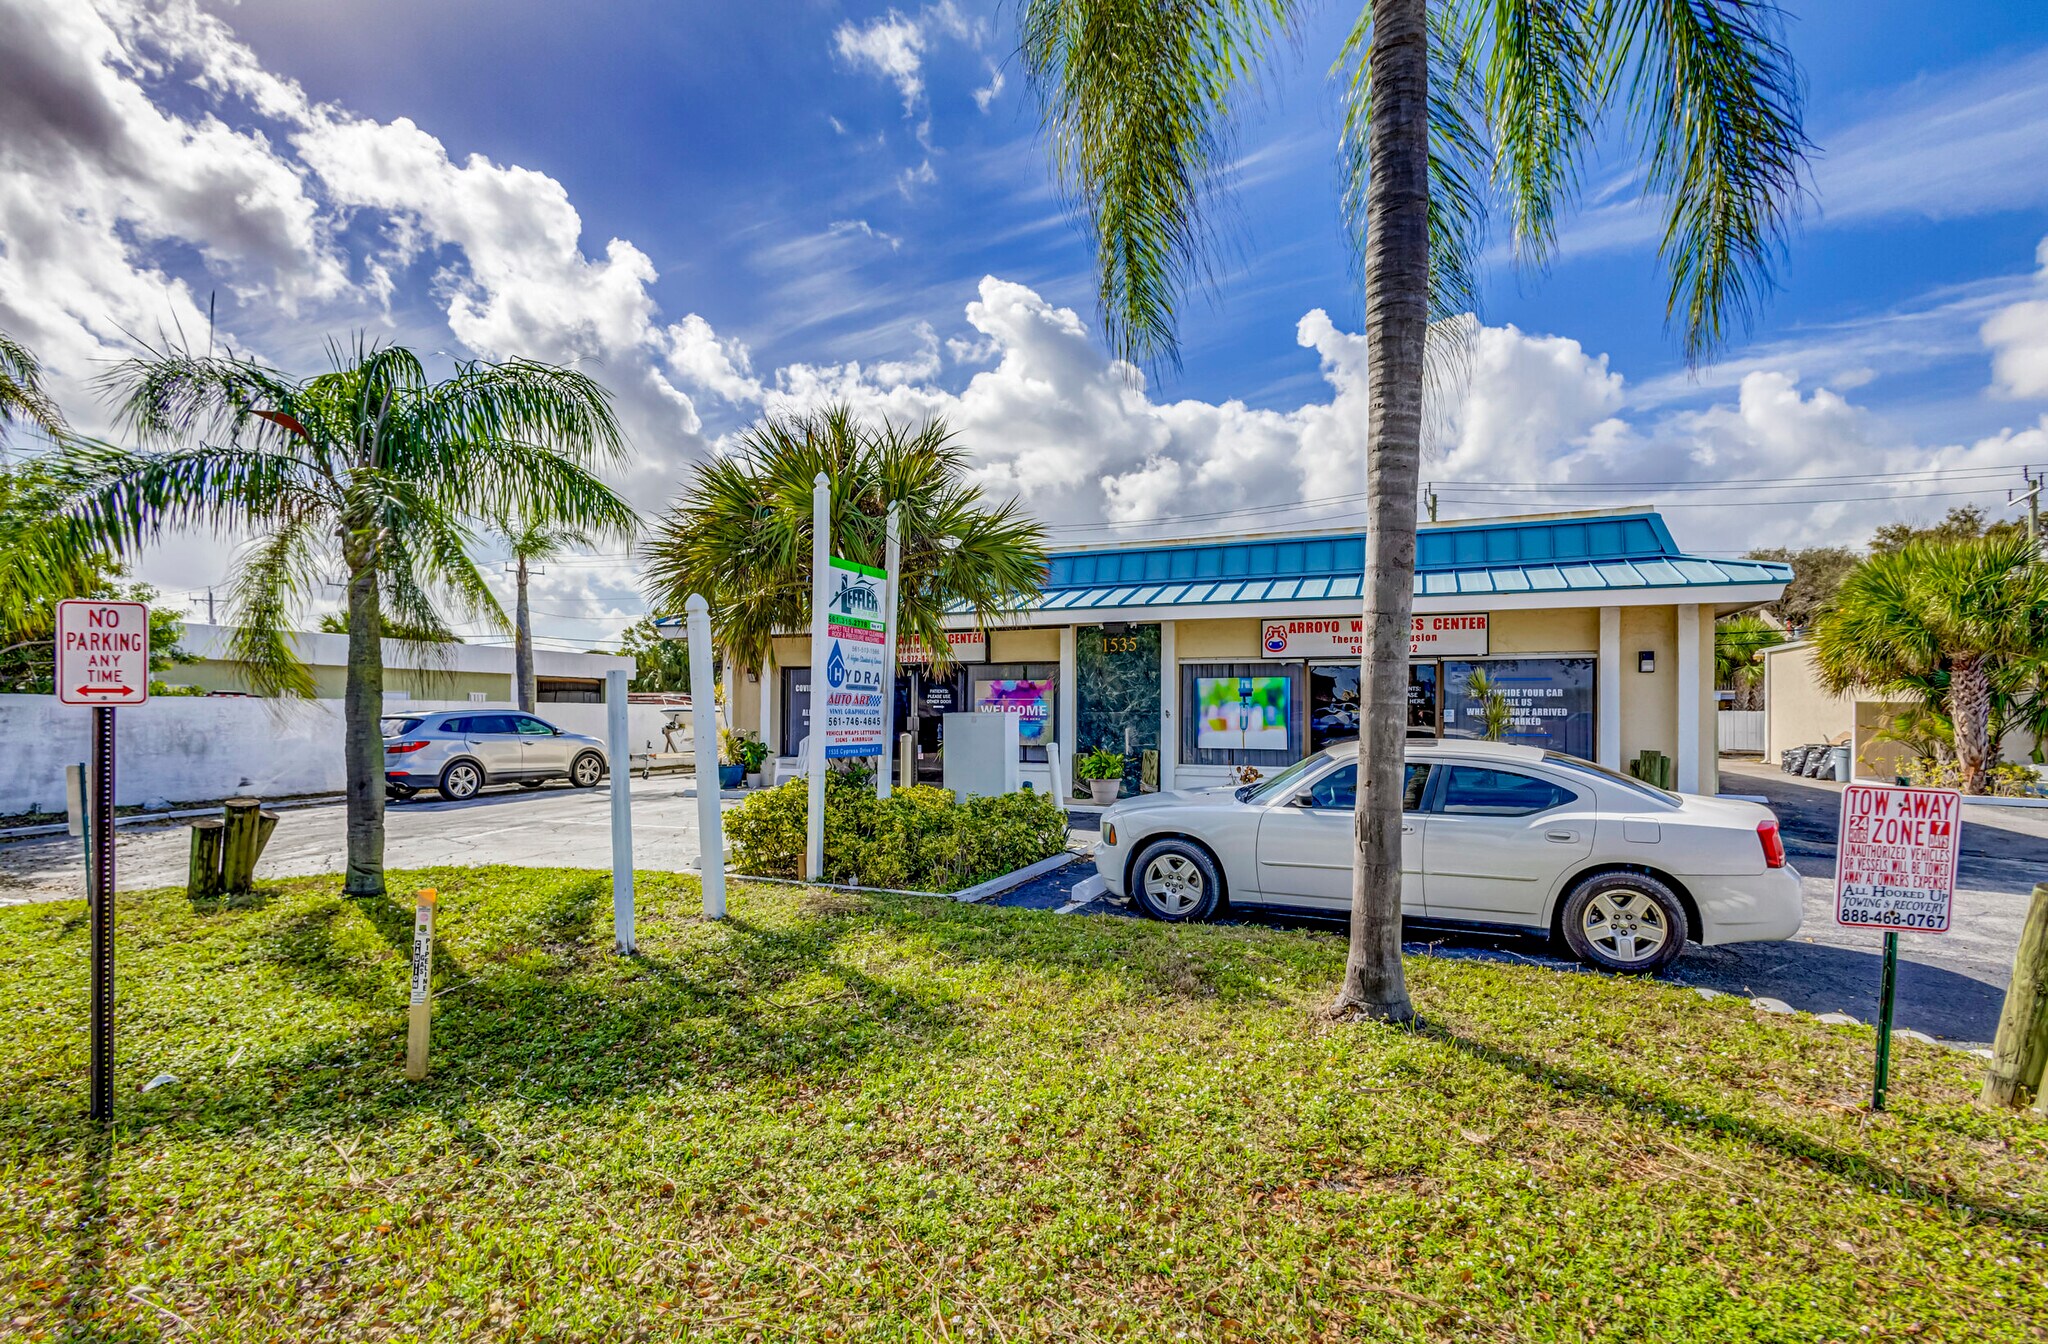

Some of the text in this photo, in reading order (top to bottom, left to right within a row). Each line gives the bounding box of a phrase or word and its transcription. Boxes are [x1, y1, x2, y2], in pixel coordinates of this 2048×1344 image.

[89, 609, 119, 628] NO
[1289, 621, 1340, 633] ARROYO
[1433, 617, 1485, 630] CENTER
[66, 632, 141, 652] PARKING
[1103, 638, 1136, 652] 1535
[88, 655, 121, 666] ANY
[87, 670, 122, 682] TIME
[834, 668, 880, 684] HYDRA
[828, 694, 870, 705] AUTO ART
[980, 705, 1047, 716] WELCOME
[828, 717, 880, 726] 561-746-4645
[1851, 790, 1954, 820] TOW AWAY
[1850, 816, 1868, 830] 24
[1935, 822, 1944, 834] 7
[1872, 819, 1925, 846] ZONE
[1930, 835, 1948, 847] DAYS
[1845, 844, 1950, 862] UNAUTHORIZED VEHICLES
[1844, 857, 1948, 876] OR VESSELS WILL BE TOWED
[1843, 871, 1948, 890] AWAY AT OWNERS EXPENSE
[1843, 897, 1881, 909] TOWING
[1893, 900, 1945, 914] RECOVERY
[1842, 909, 1945, 928] 888-468-0767
